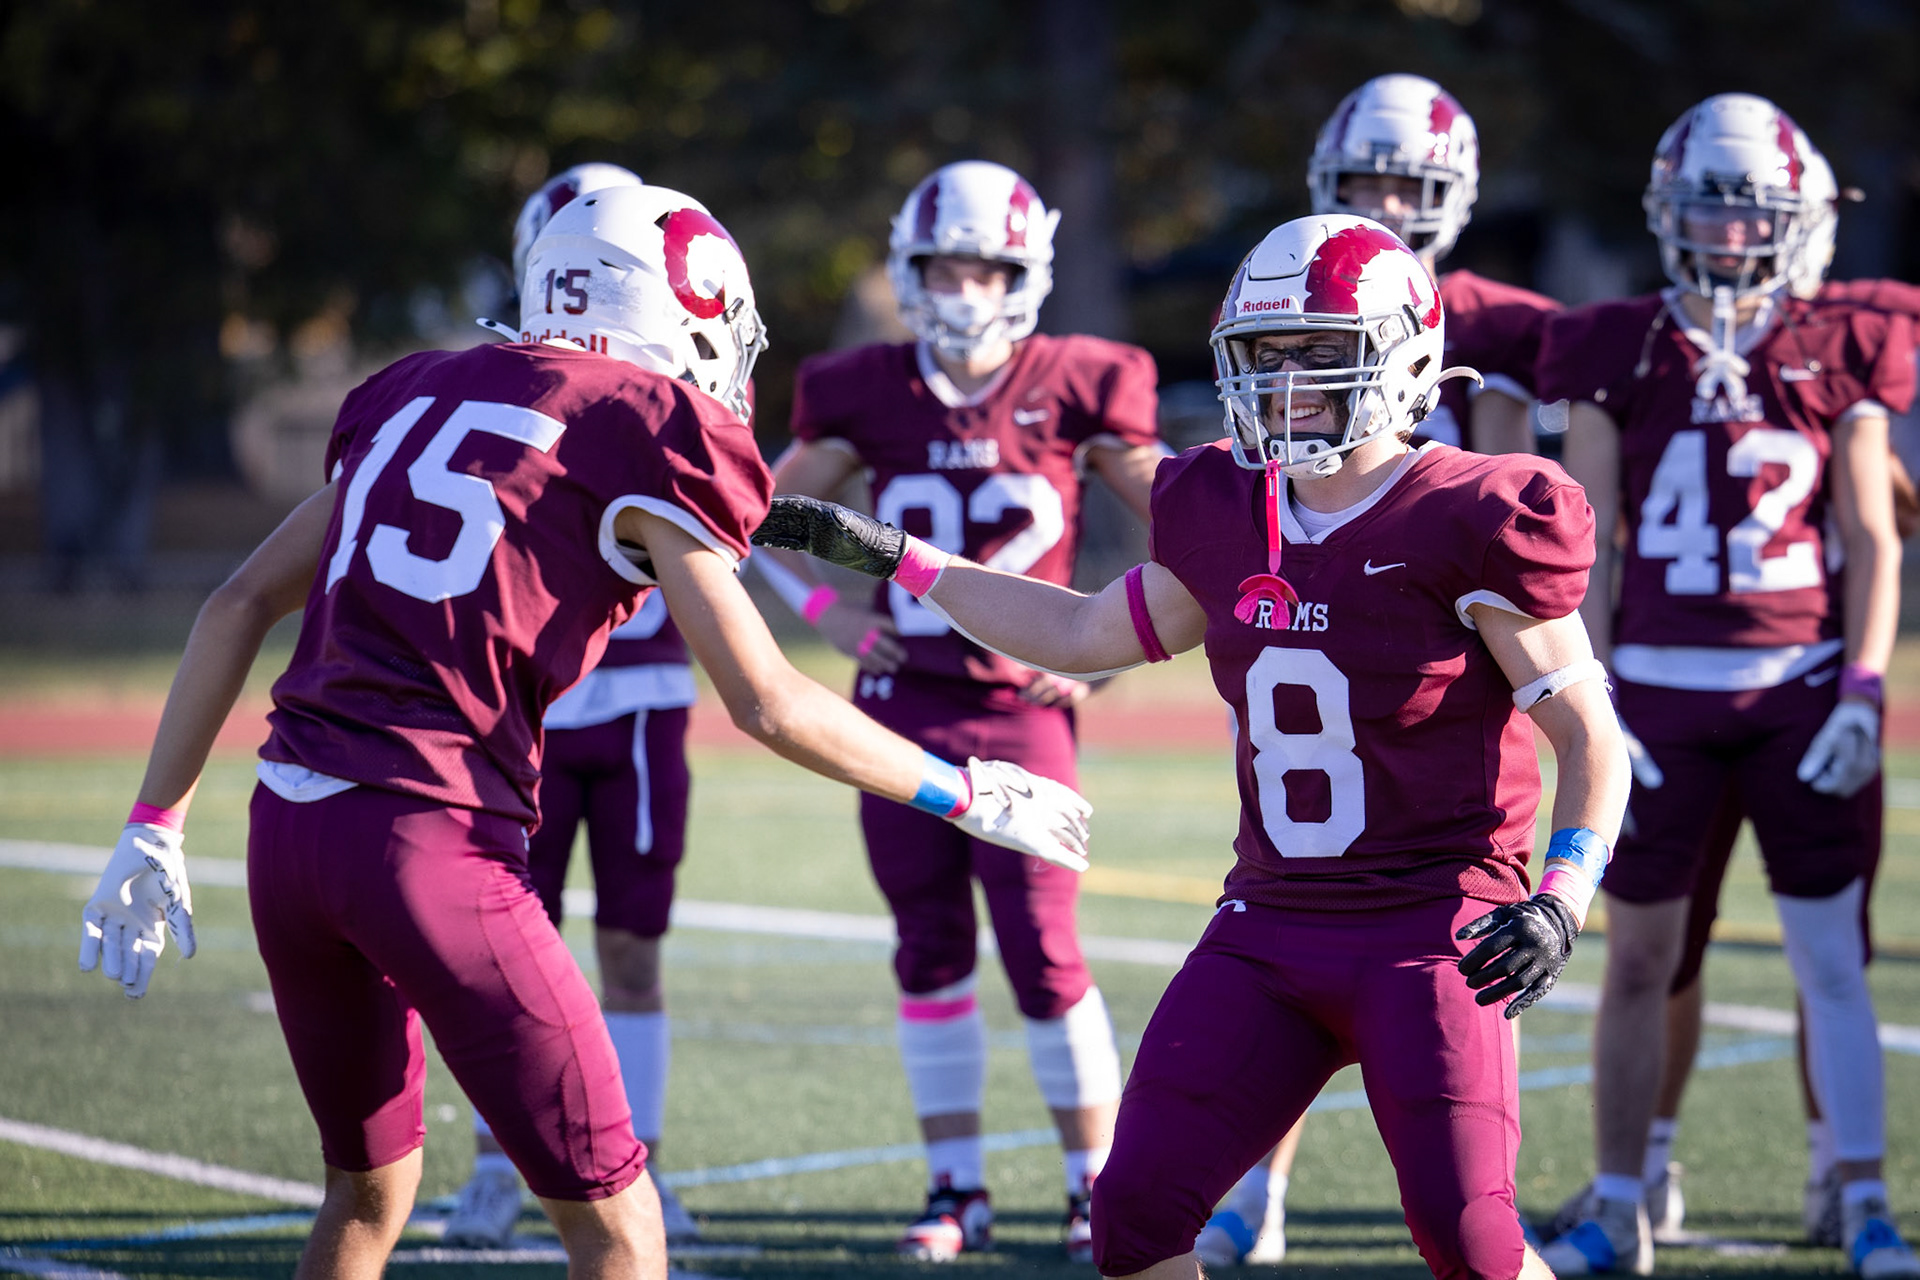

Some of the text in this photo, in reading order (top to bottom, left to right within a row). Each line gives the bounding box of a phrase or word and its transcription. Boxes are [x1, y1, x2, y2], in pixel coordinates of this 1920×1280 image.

[545, 269, 590, 315] 15
[325, 396, 567, 604] 15
[1637, 429, 1821, 595] 42
[1255, 600, 1329, 631] RMS
[1246, 646, 1366, 858] 8
